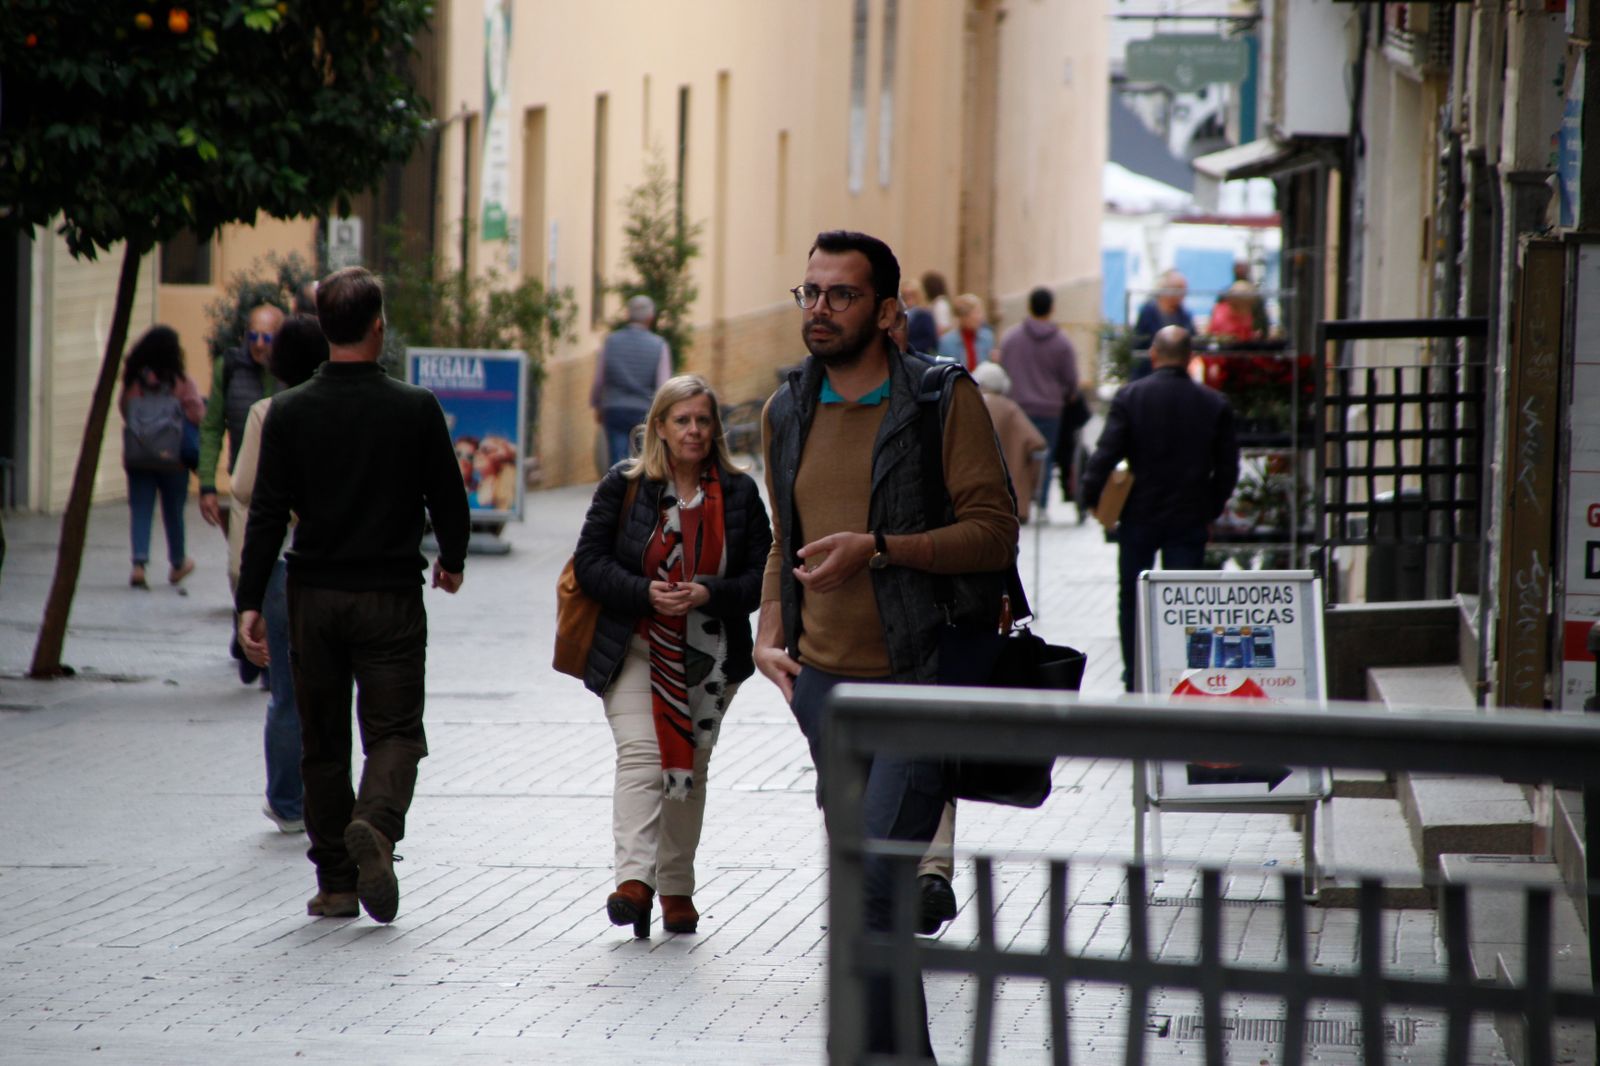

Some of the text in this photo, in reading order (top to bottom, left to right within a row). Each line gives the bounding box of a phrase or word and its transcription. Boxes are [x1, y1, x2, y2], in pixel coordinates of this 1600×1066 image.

[419, 356, 484, 378] REGALA
[1162, 585, 1294, 605] CALCULADORAS
[1163, 608, 1295, 625] CIENTIFICAS
[1206, 674, 1227, 687] ctt
